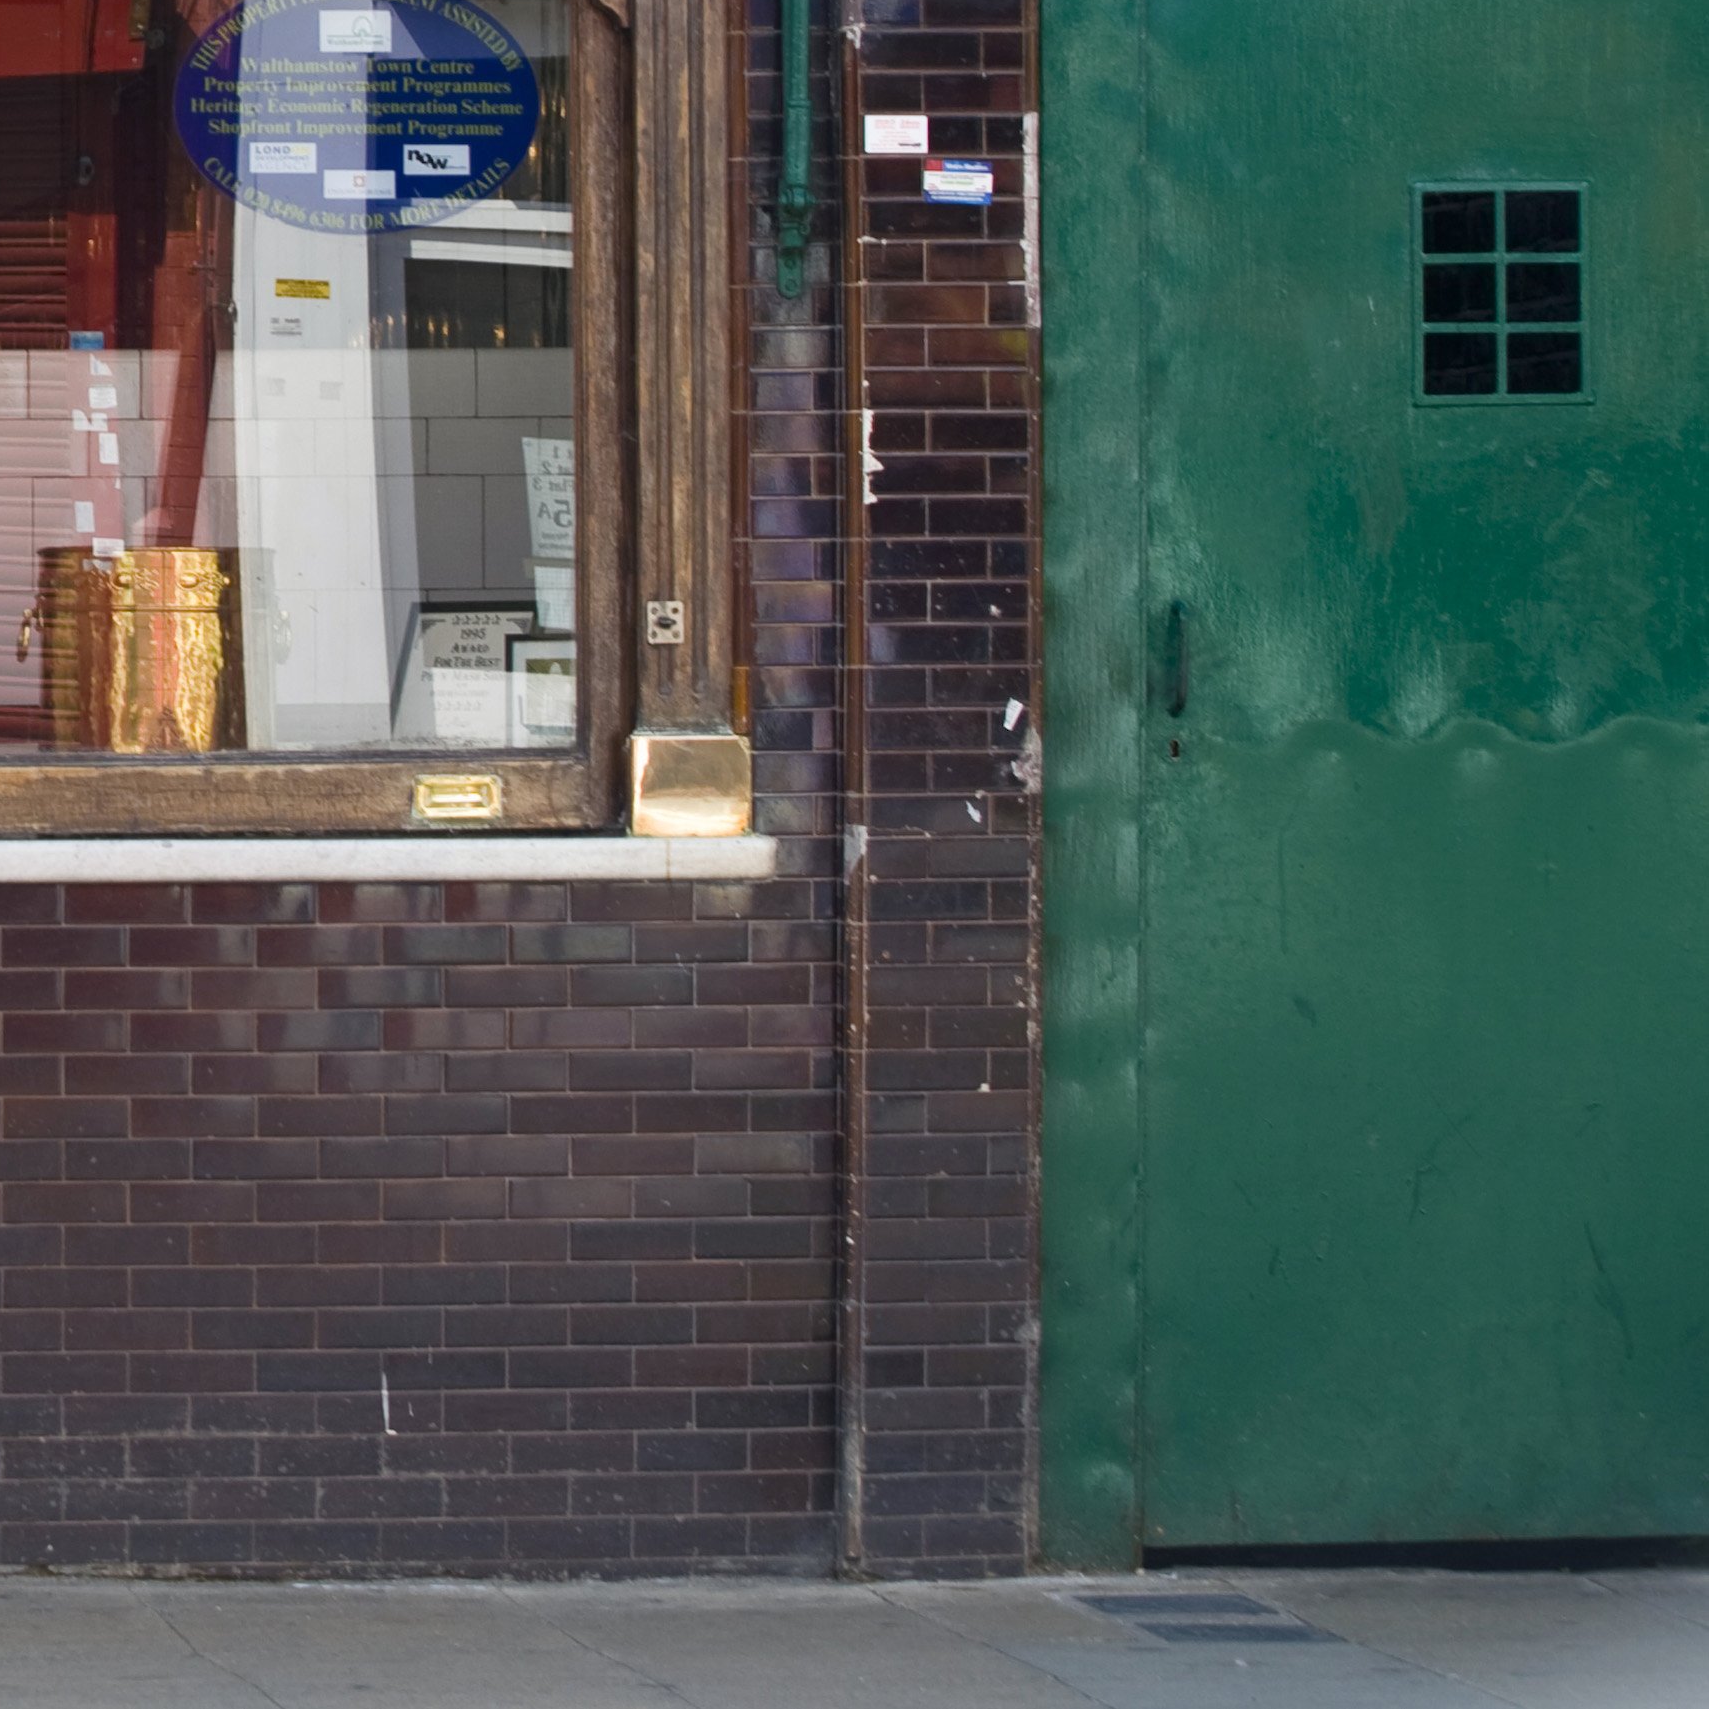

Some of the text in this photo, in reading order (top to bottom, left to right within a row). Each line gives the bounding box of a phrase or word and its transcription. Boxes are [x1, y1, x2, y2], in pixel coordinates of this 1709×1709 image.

[416, 57, 475, 74] Centre
[203, 76, 512, 96] Property Improvement Programmes
[190, 97, 524, 116] Heritage Economic Regeneration Scheme
[207, 118, 504, 138] Shopfront Improvement Programme
